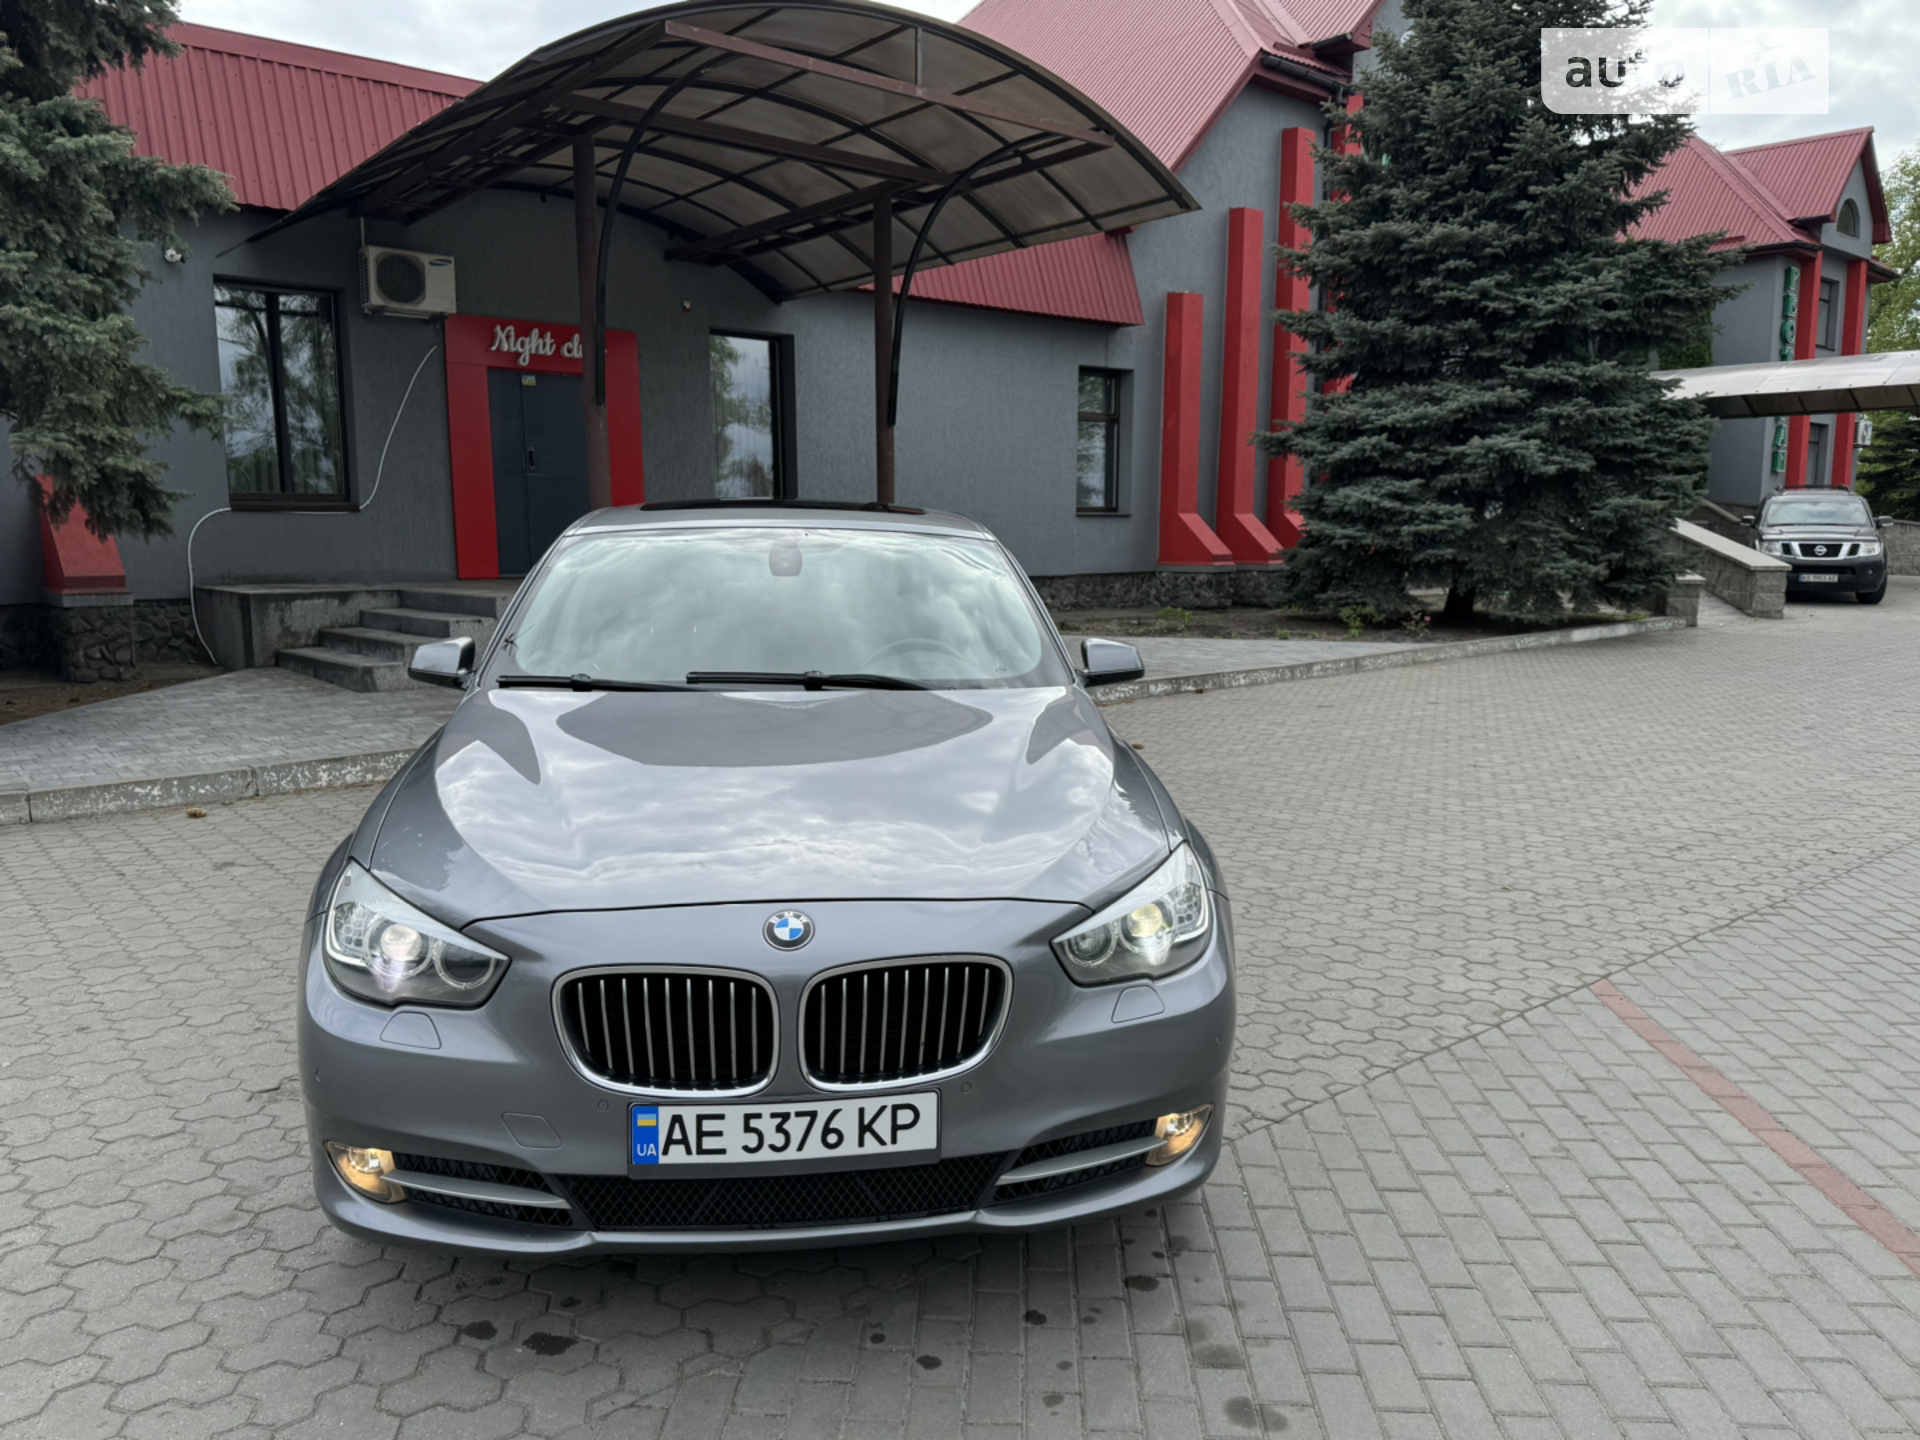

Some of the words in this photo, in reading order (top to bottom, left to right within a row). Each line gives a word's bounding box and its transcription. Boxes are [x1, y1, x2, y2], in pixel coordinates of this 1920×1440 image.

[490, 325, 556, 367] Night
[636, 1143, 657, 1157] UA
[662, 1113, 727, 1155] AE
[741, 1108, 845, 1154] 5376
[857, 1103, 921, 1148] KP
